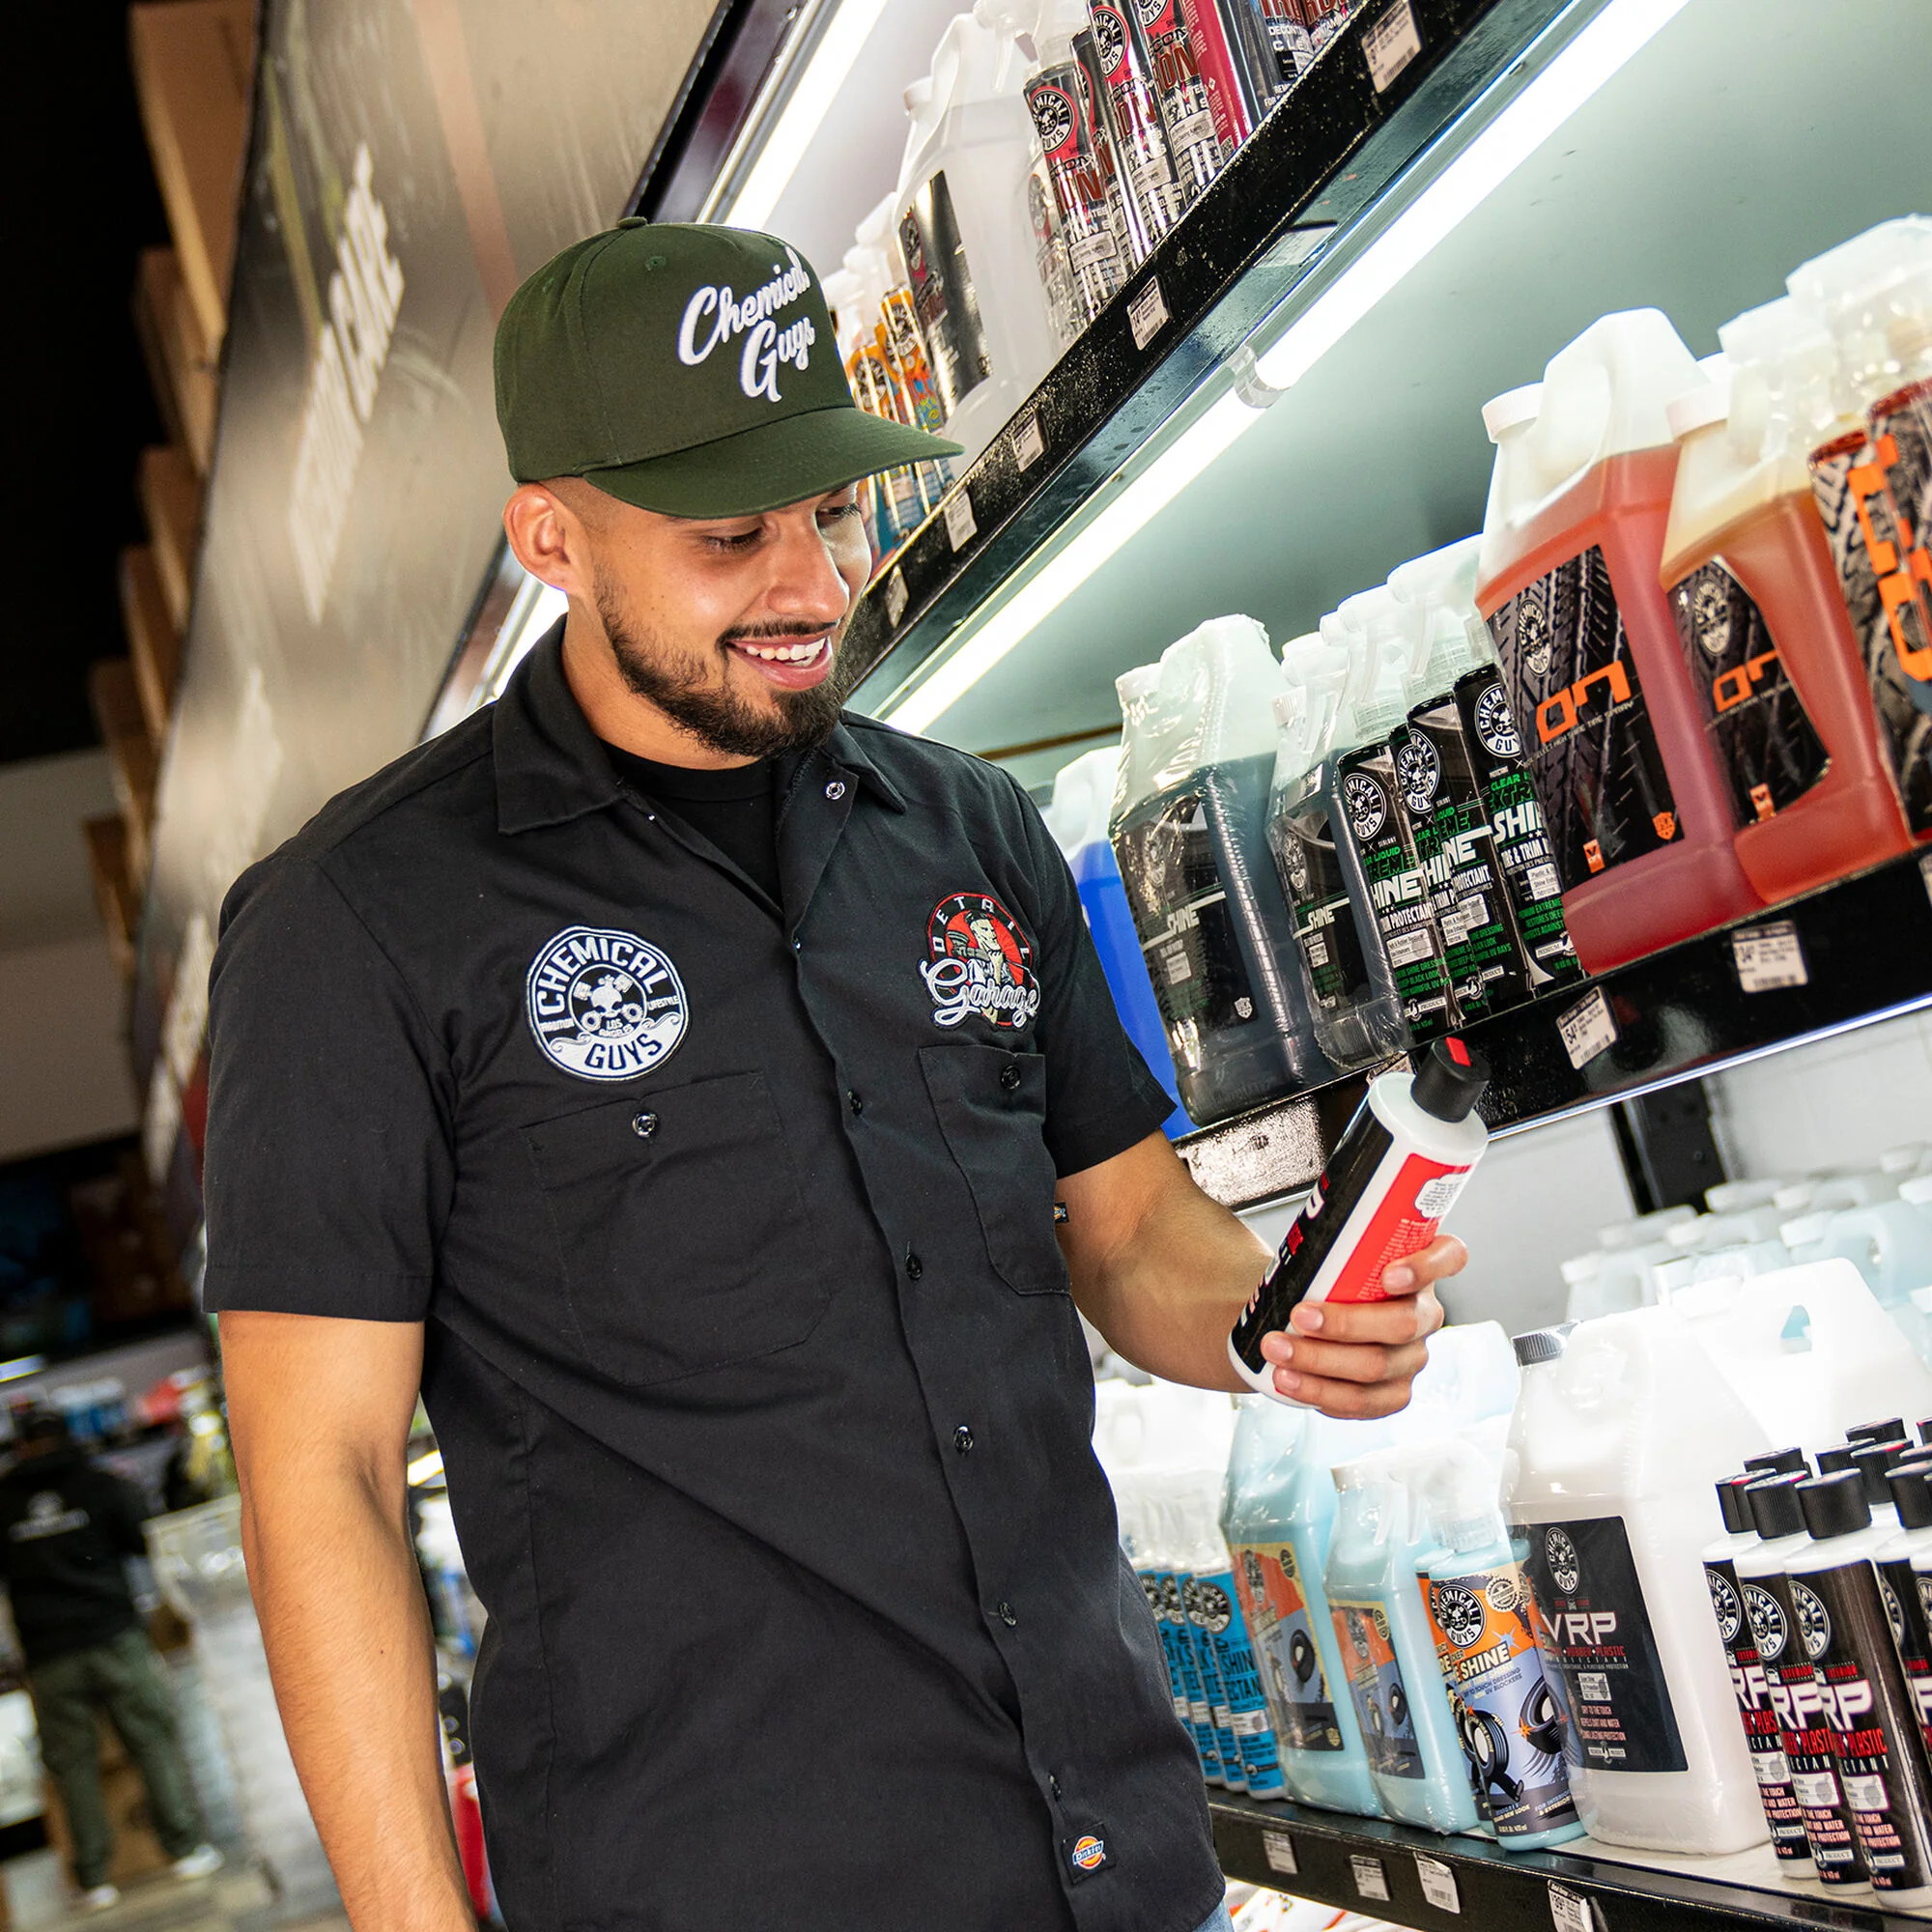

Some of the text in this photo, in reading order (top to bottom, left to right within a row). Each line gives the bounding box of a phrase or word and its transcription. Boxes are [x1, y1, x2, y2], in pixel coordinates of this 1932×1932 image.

[678, 245, 810, 366] Chemical
[740, 317, 815, 403] Guys
[1479, 689, 1504, 729] CHEM
[1491, 773, 1521, 791] CLEAR
[1374, 846, 1401, 863] LIQUID
[536, 936, 668, 1016] CHEMICAL
[584, 1032, 664, 1070] GUYS
[1541, 1611, 1617, 1646] VRP
[1460, 1642, 1512, 1680] SHINE
[1847, 1727, 1889, 1758] PLASTIC
